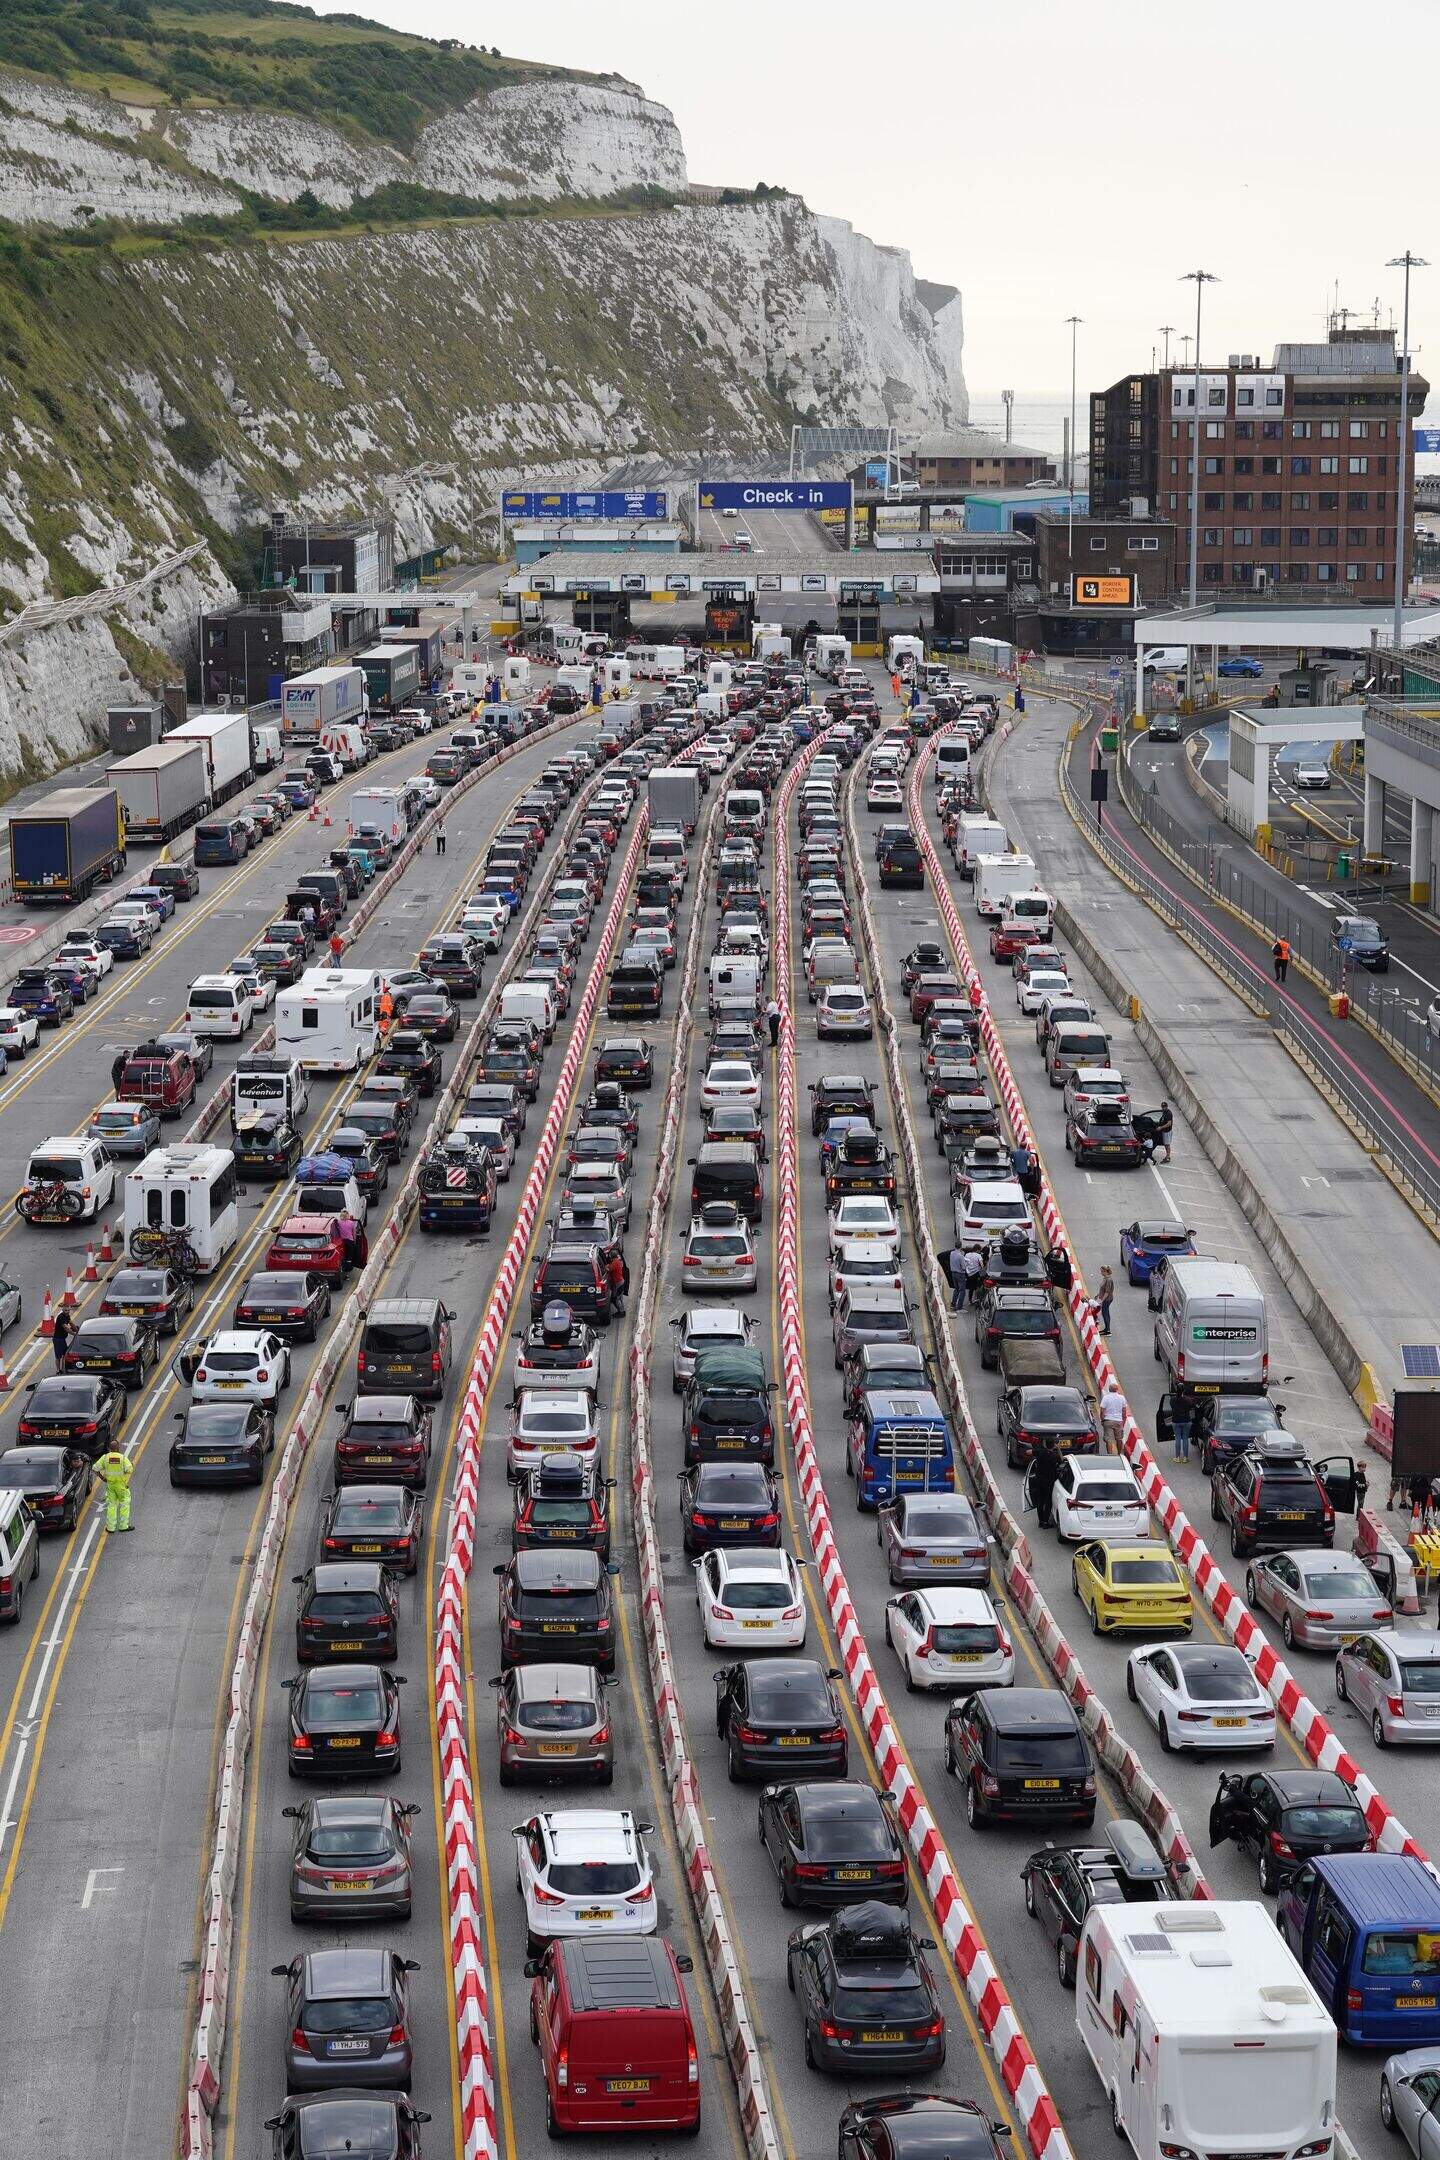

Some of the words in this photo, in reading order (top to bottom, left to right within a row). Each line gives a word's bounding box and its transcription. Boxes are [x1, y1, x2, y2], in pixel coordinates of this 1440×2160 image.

[743, 489, 794, 503] Check
[809, 489, 823, 503] in
[557, 531, 561, 539] 1
[630, 531, 636, 539] 2
[916, 539, 921, 547] 3
[287, 690, 316, 701] EMY
[1193, 1329, 1256, 1339] enterprise
[1041, 1779, 1054, 1787] LRS
[838, 1870, 856, 1879] LR62
[81, 1868, 125, 1908] F
[334, 1881, 352, 1889] NU57
[866, 2032, 885, 2040] YH64
[612, 2081, 631, 2090] YE07
[633, 2081, 648, 2089] BJX
